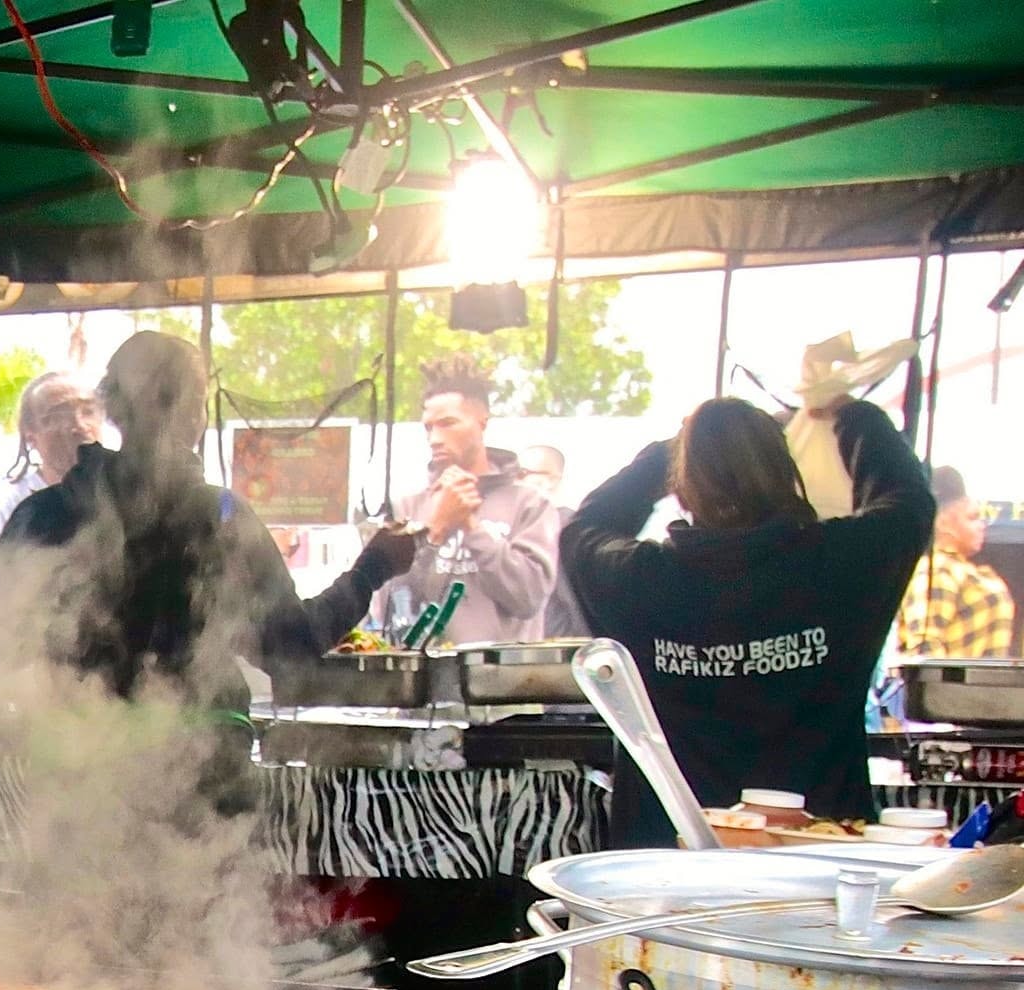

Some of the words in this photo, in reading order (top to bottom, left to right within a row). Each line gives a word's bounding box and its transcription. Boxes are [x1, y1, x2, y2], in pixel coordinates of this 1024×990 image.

[654, 638, 699, 660] HAVE
[702, 644, 745, 662] YOU
[749, 632, 799, 660] BEEN
[802, 626, 827, 648] TO
[655, 656, 736, 677] RAFIKIZ
[743, 645, 828, 675] FOODZ?
